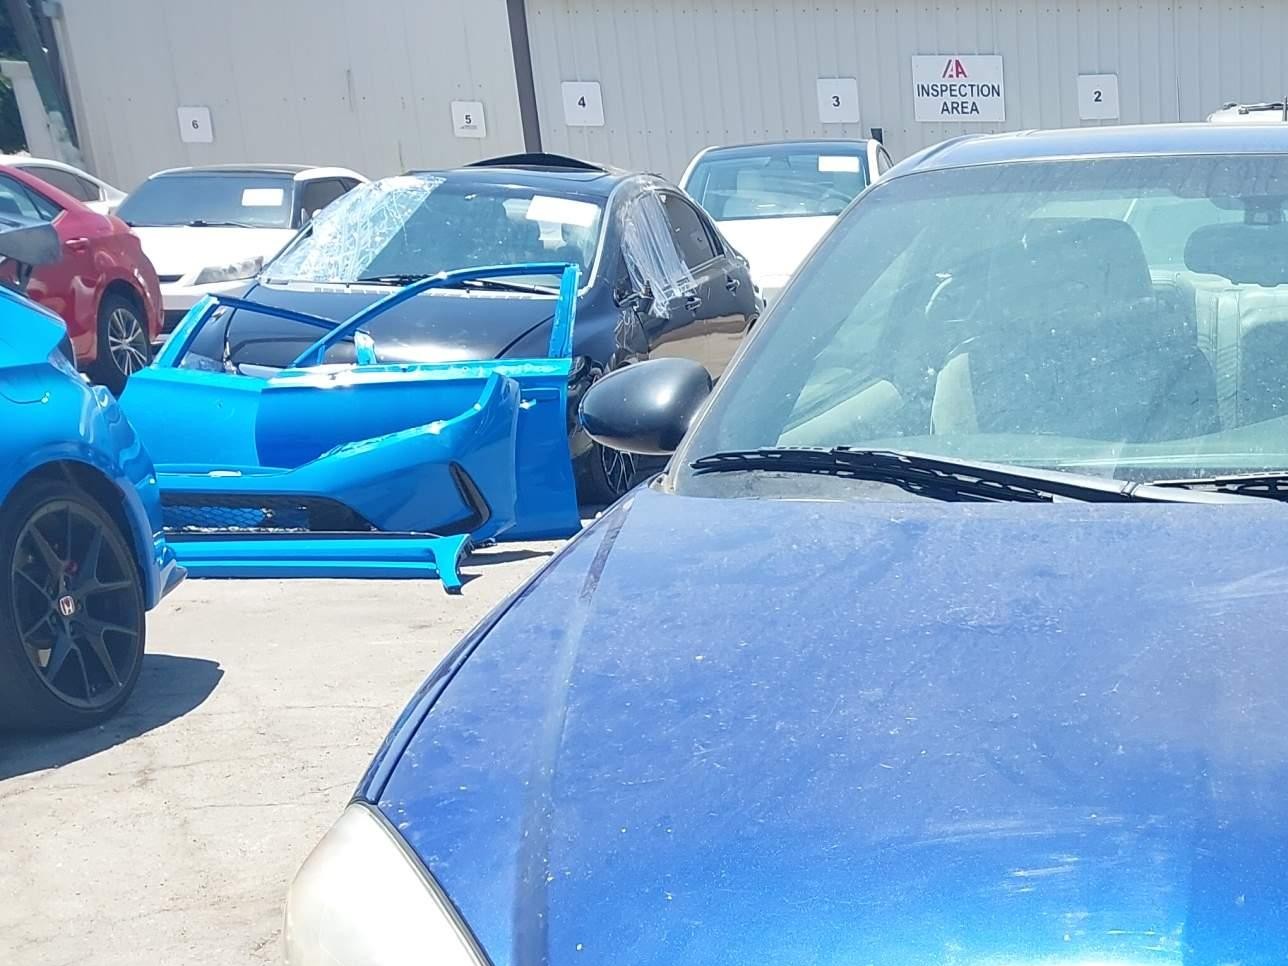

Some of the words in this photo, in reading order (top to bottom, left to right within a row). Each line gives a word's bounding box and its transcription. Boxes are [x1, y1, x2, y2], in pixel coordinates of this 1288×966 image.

[917, 83, 1001, 97] INSPECTION
[1093, 90, 1103, 103] 2
[577, 96, 587, 108] 4
[831, 95, 841, 108] 3
[941, 101, 980, 115] AREA
[191, 119, 199, 130] 6
[465, 114, 472, 124] 5
